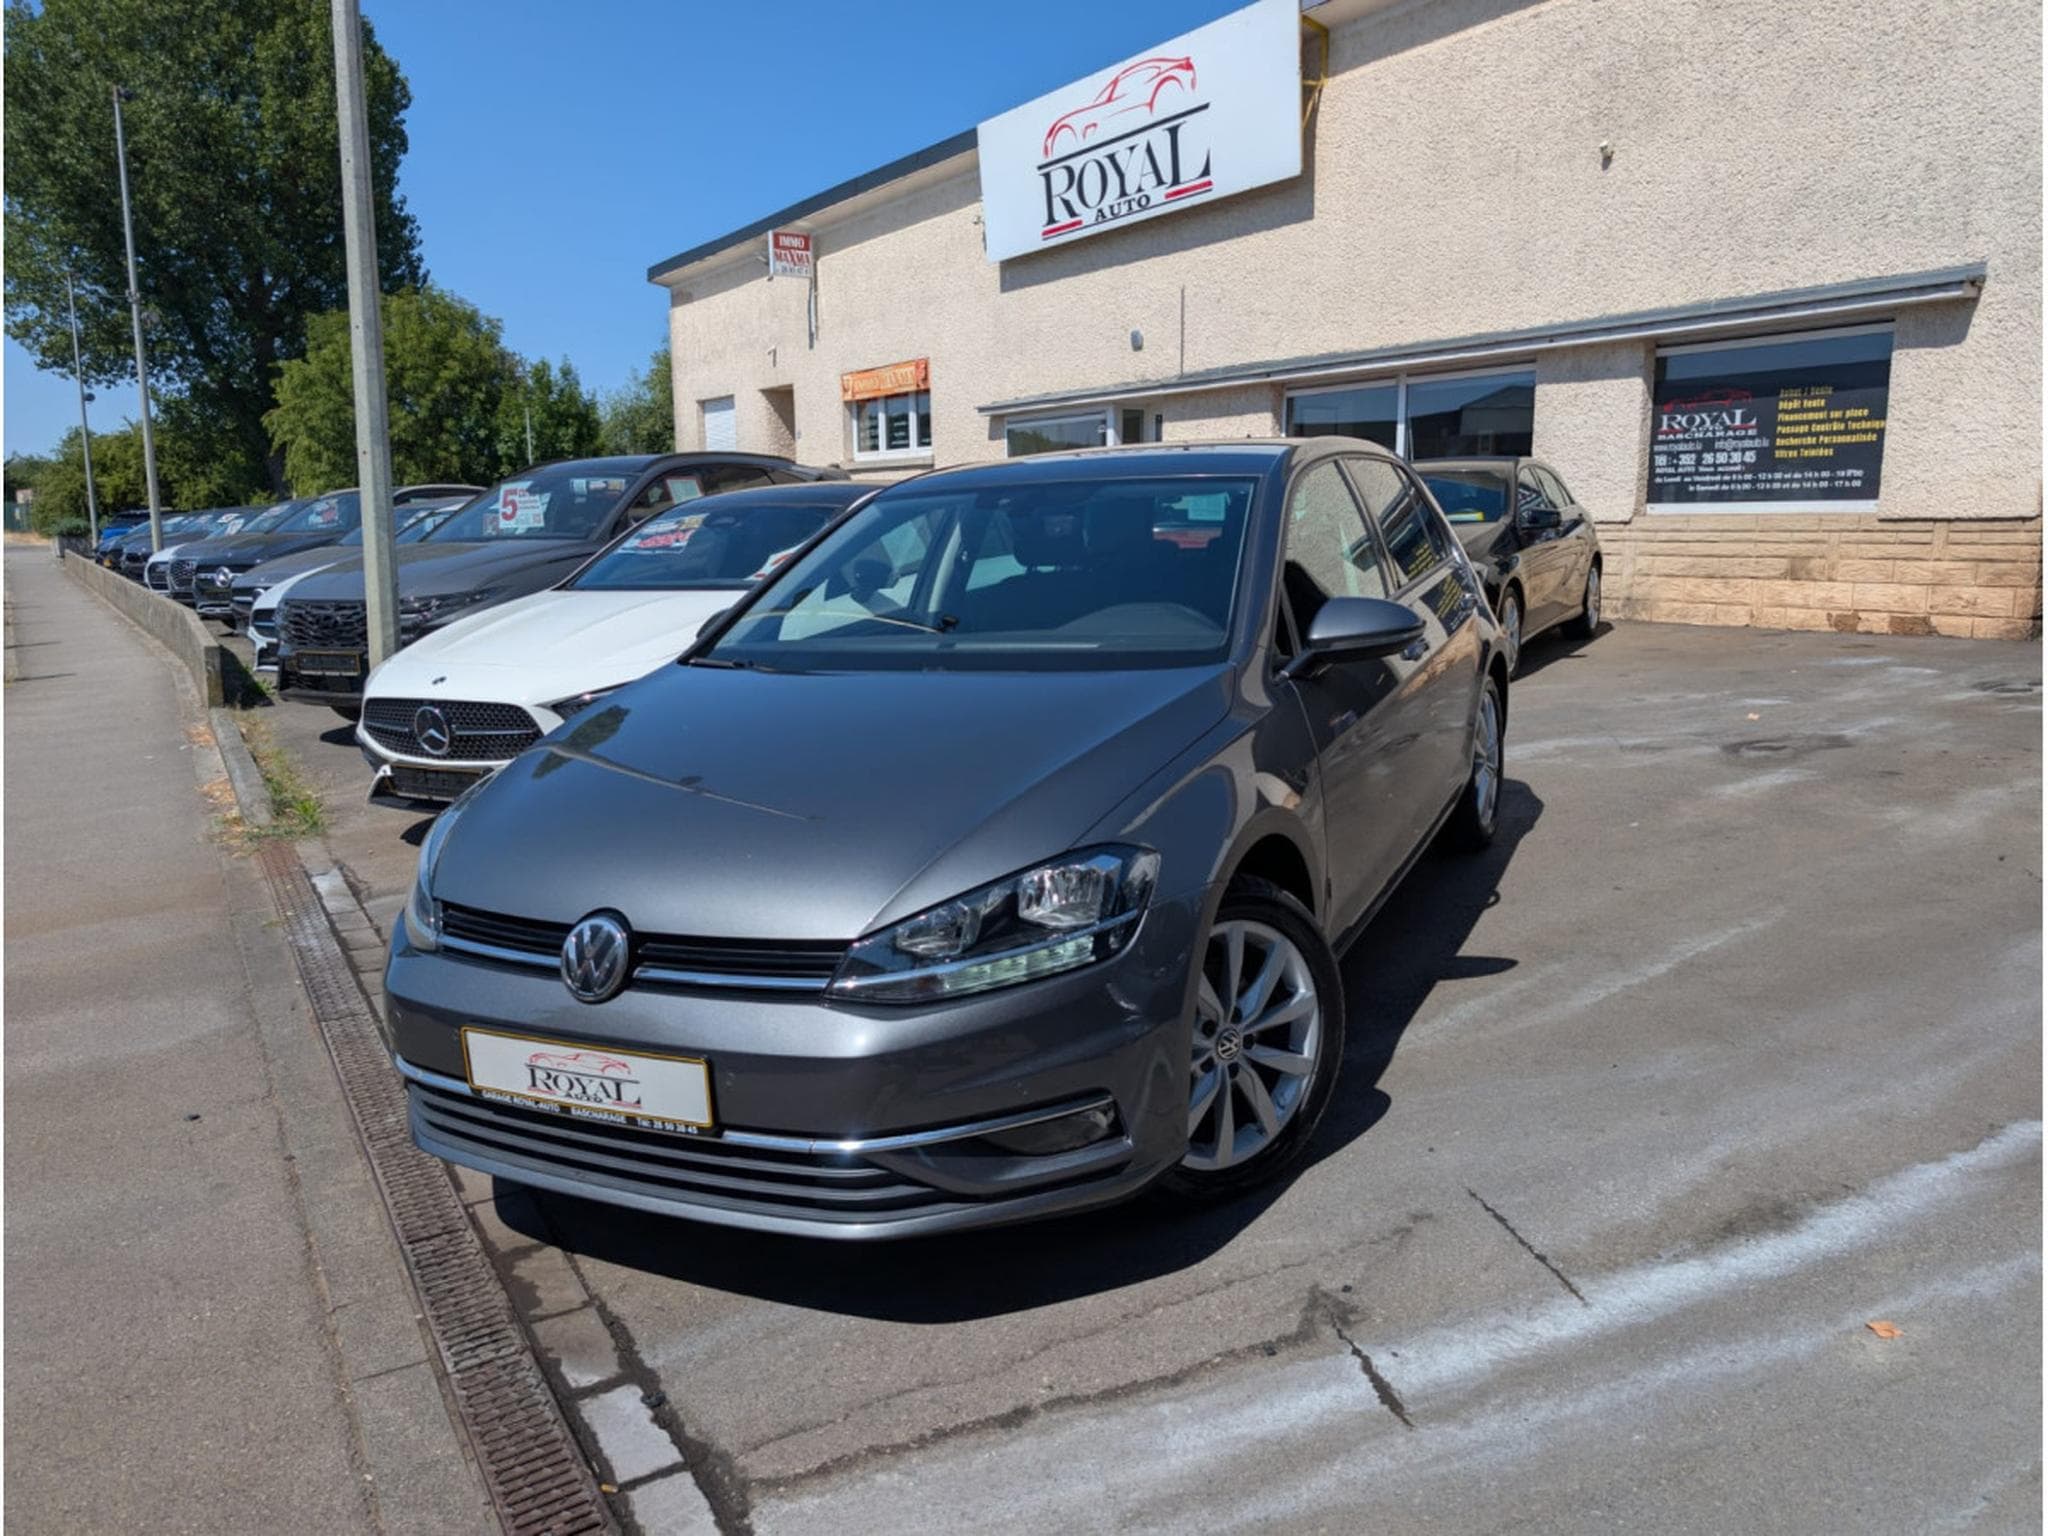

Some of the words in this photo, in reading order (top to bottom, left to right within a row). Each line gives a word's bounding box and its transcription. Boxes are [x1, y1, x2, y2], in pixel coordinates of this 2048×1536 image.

[1039, 120, 1212, 227] ROYAL
[1094, 193, 1151, 225] AUTO
[1661, 408, 1757, 431] ROYAL
[502, 488, 518, 521] 5
[529, 1067, 642, 1104] ROYAL
[564, 1092, 603, 1104] AUTO
